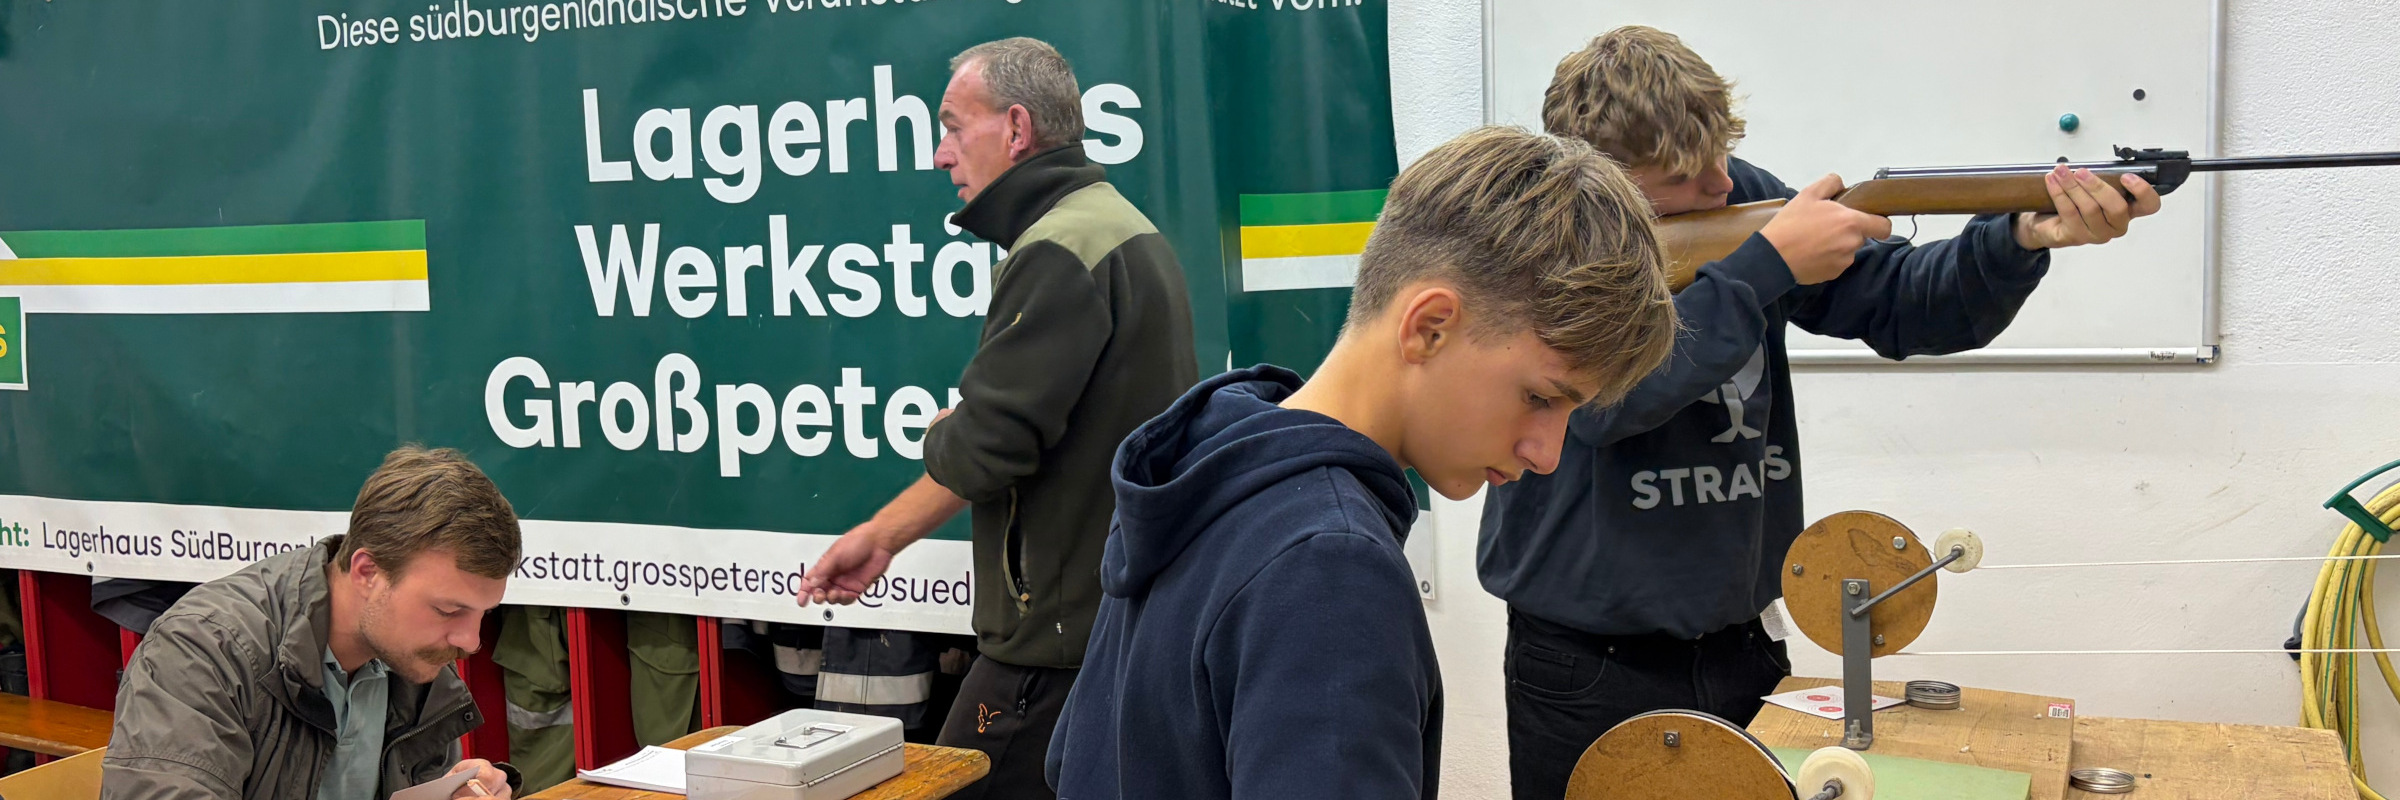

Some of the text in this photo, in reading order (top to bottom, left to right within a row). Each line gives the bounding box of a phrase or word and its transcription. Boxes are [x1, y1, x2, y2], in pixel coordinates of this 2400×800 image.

[317, 13, 400, 50] Diese
[583, 64, 1144, 204] Lagerhs
[574, 211, 1008, 318] Werkstä
[484, 352, 964, 478] Großpete
[42, 521, 163, 559] Lagerhaus
